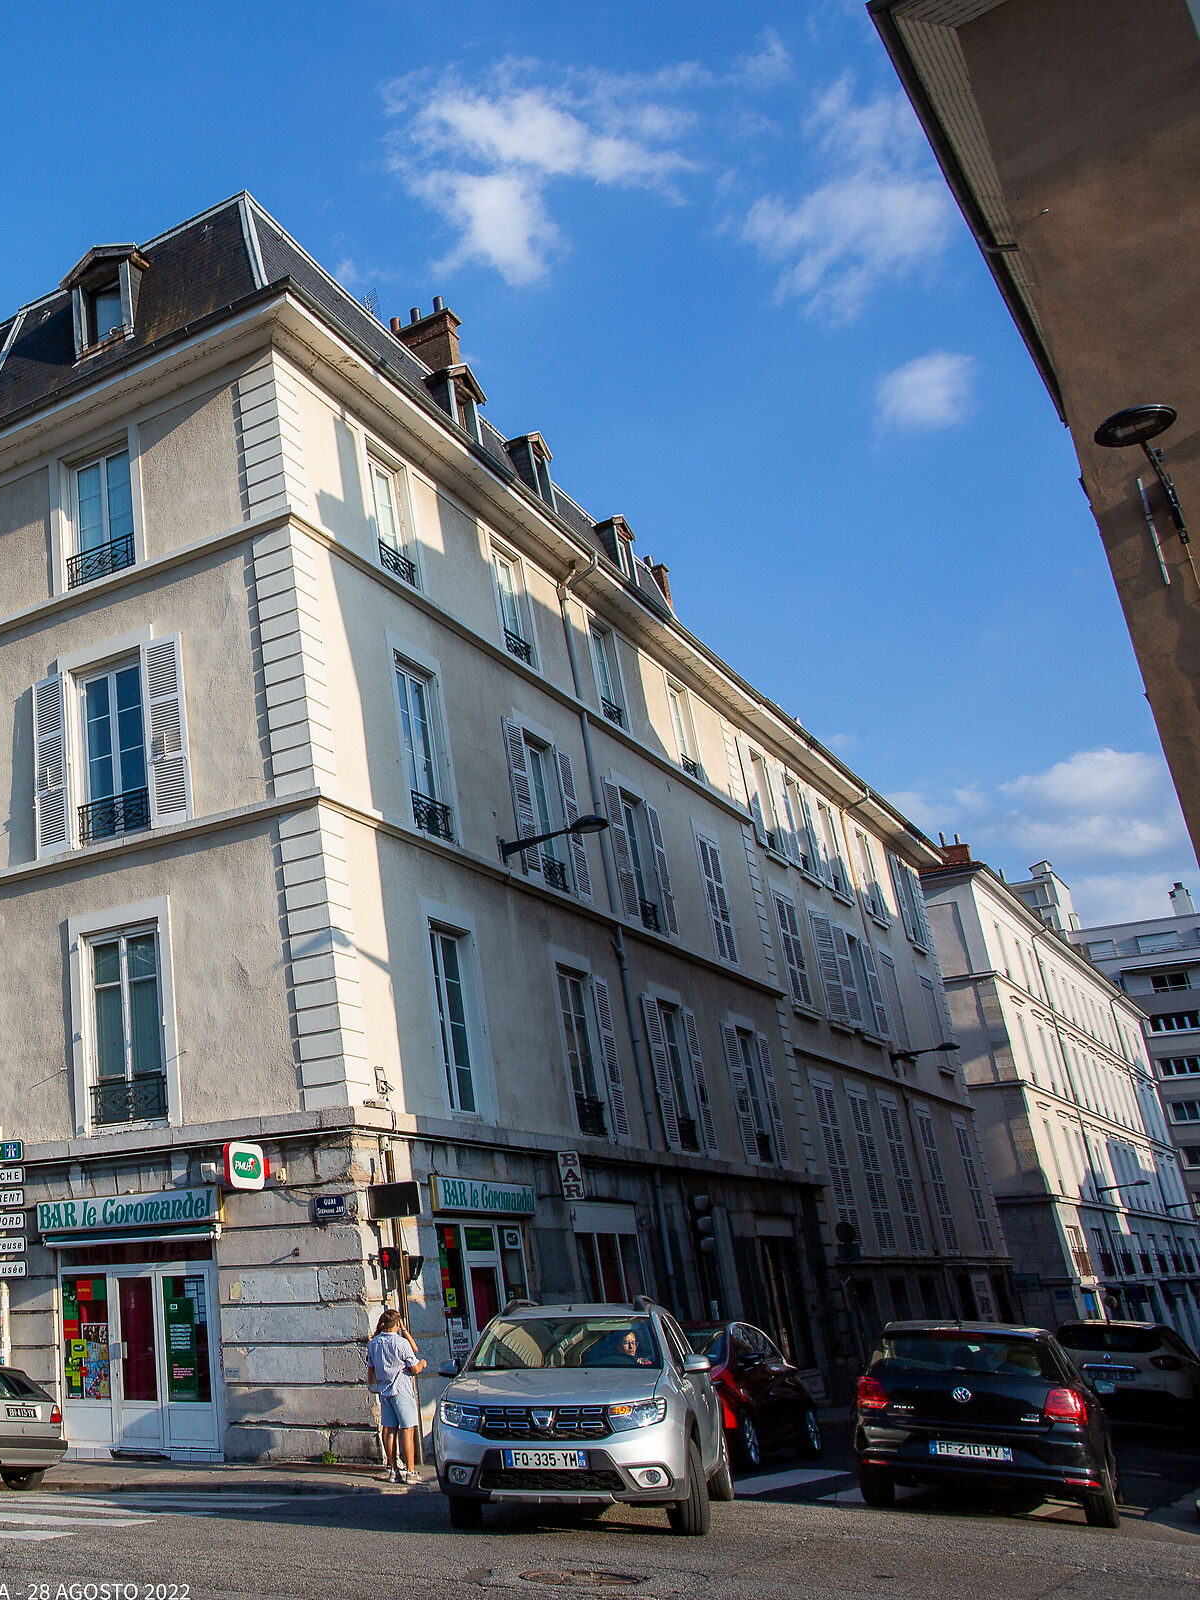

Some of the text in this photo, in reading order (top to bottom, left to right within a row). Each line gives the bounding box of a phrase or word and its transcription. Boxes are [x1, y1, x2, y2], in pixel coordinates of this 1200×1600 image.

[442, 1179, 535, 1212] BAR le Coromandel
[560, 1154, 584, 1198] BAR
[39, 1190, 213, 1230] BAR le Coromandel
